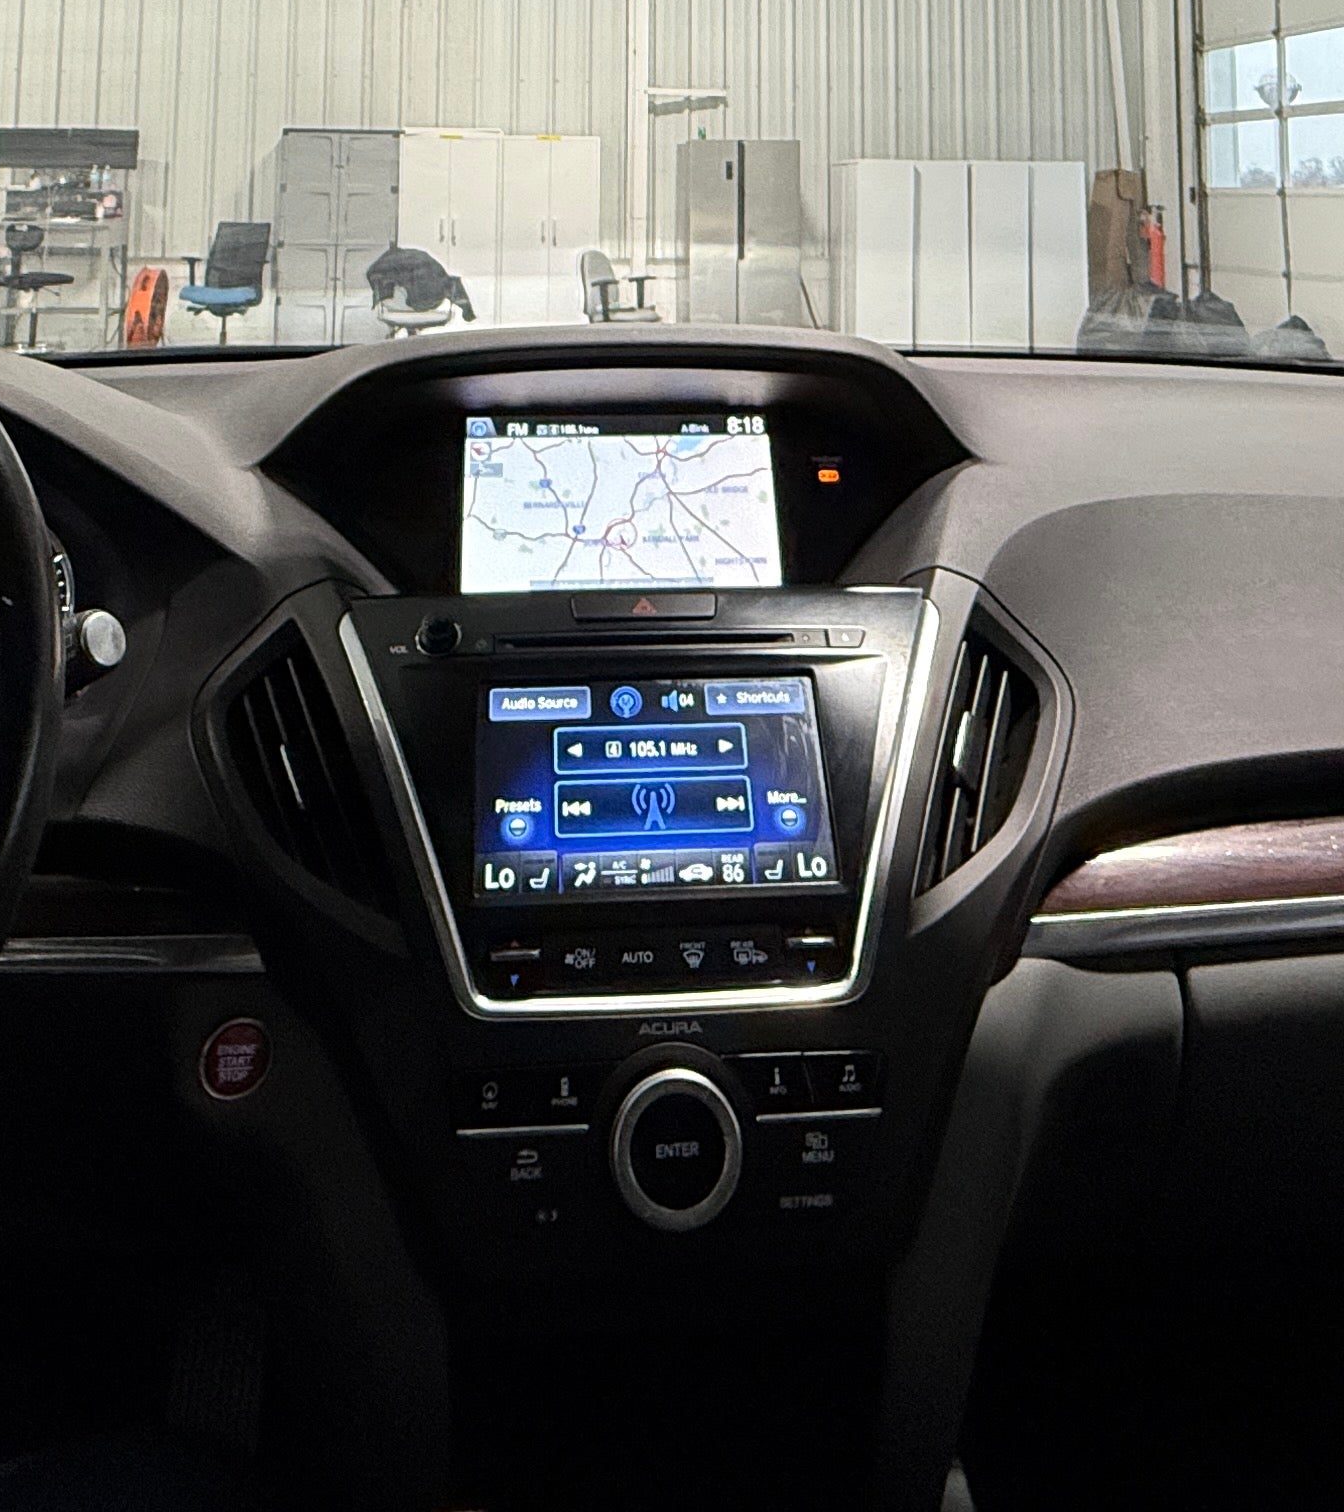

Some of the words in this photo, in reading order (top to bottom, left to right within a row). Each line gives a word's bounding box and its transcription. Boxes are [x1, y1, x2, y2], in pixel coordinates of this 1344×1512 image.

[507, 422, 529, 436] FM
[726, 416, 765, 434] 8:18
[389, 645, 409, 655] VOL
[501, 696, 536, 711] Audio
[537, 695, 578, 710] Source
[679, 693, 695, 708] 04
[736, 691, 792, 706] Shortcuts
[629, 740, 666, 758] 105.1
[670, 742, 698, 756] MHz
[495, 798, 543, 813] Presets
[720, 853, 744, 864] REAR
[797, 852, 828, 878] Lo
[484, 862, 516, 890] Lo
[722, 863, 745, 883] 86
[575, 958, 597, 970] OFF
[621, 950, 655, 964] AUTO
[637, 1021, 704, 1036] ACURA
[654, 1141, 700, 1160] ENTER
[801, 1150, 835, 1164] MENU
[510, 1167, 543, 1180] BACK
[779, 1193, 833, 1209] SETTINGS
